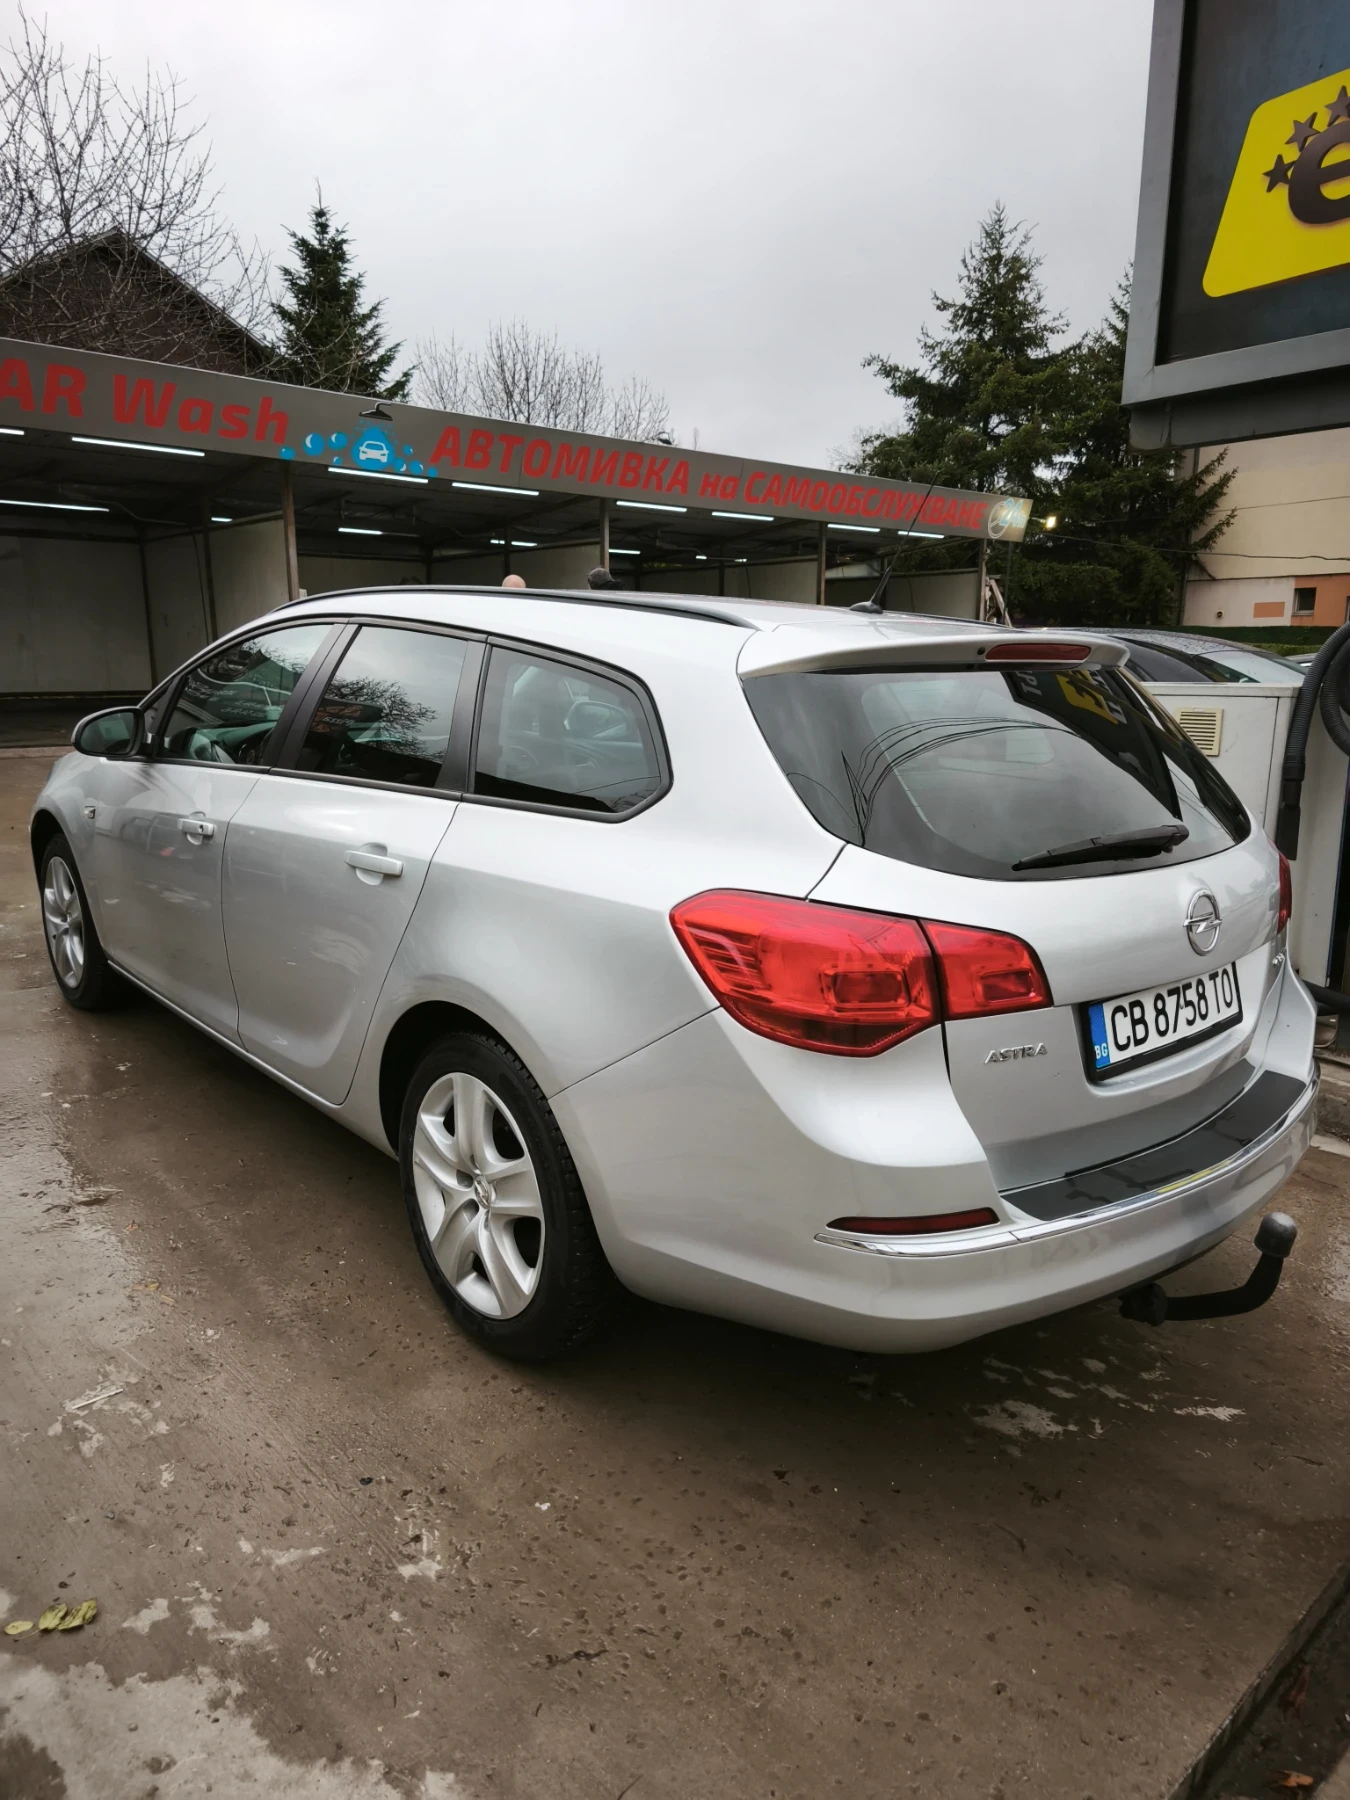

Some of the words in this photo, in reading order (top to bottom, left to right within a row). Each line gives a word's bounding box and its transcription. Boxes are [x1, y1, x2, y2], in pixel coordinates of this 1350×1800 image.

[112, 374, 289, 445] Wash
[429, 426, 690, 496] АВТОМИВКА
[698, 471, 741, 501] на
[744, 471, 988, 531] САМООБСЛУЖВАНЕ
[1110, 999, 1149, 1052] CB
[1154, 977, 1209, 1037] 8758
[1209, 967, 1233, 1013] TO
[984, 1042, 1048, 1065] ASTRA
[1095, 1043, 1109, 1061] BG
